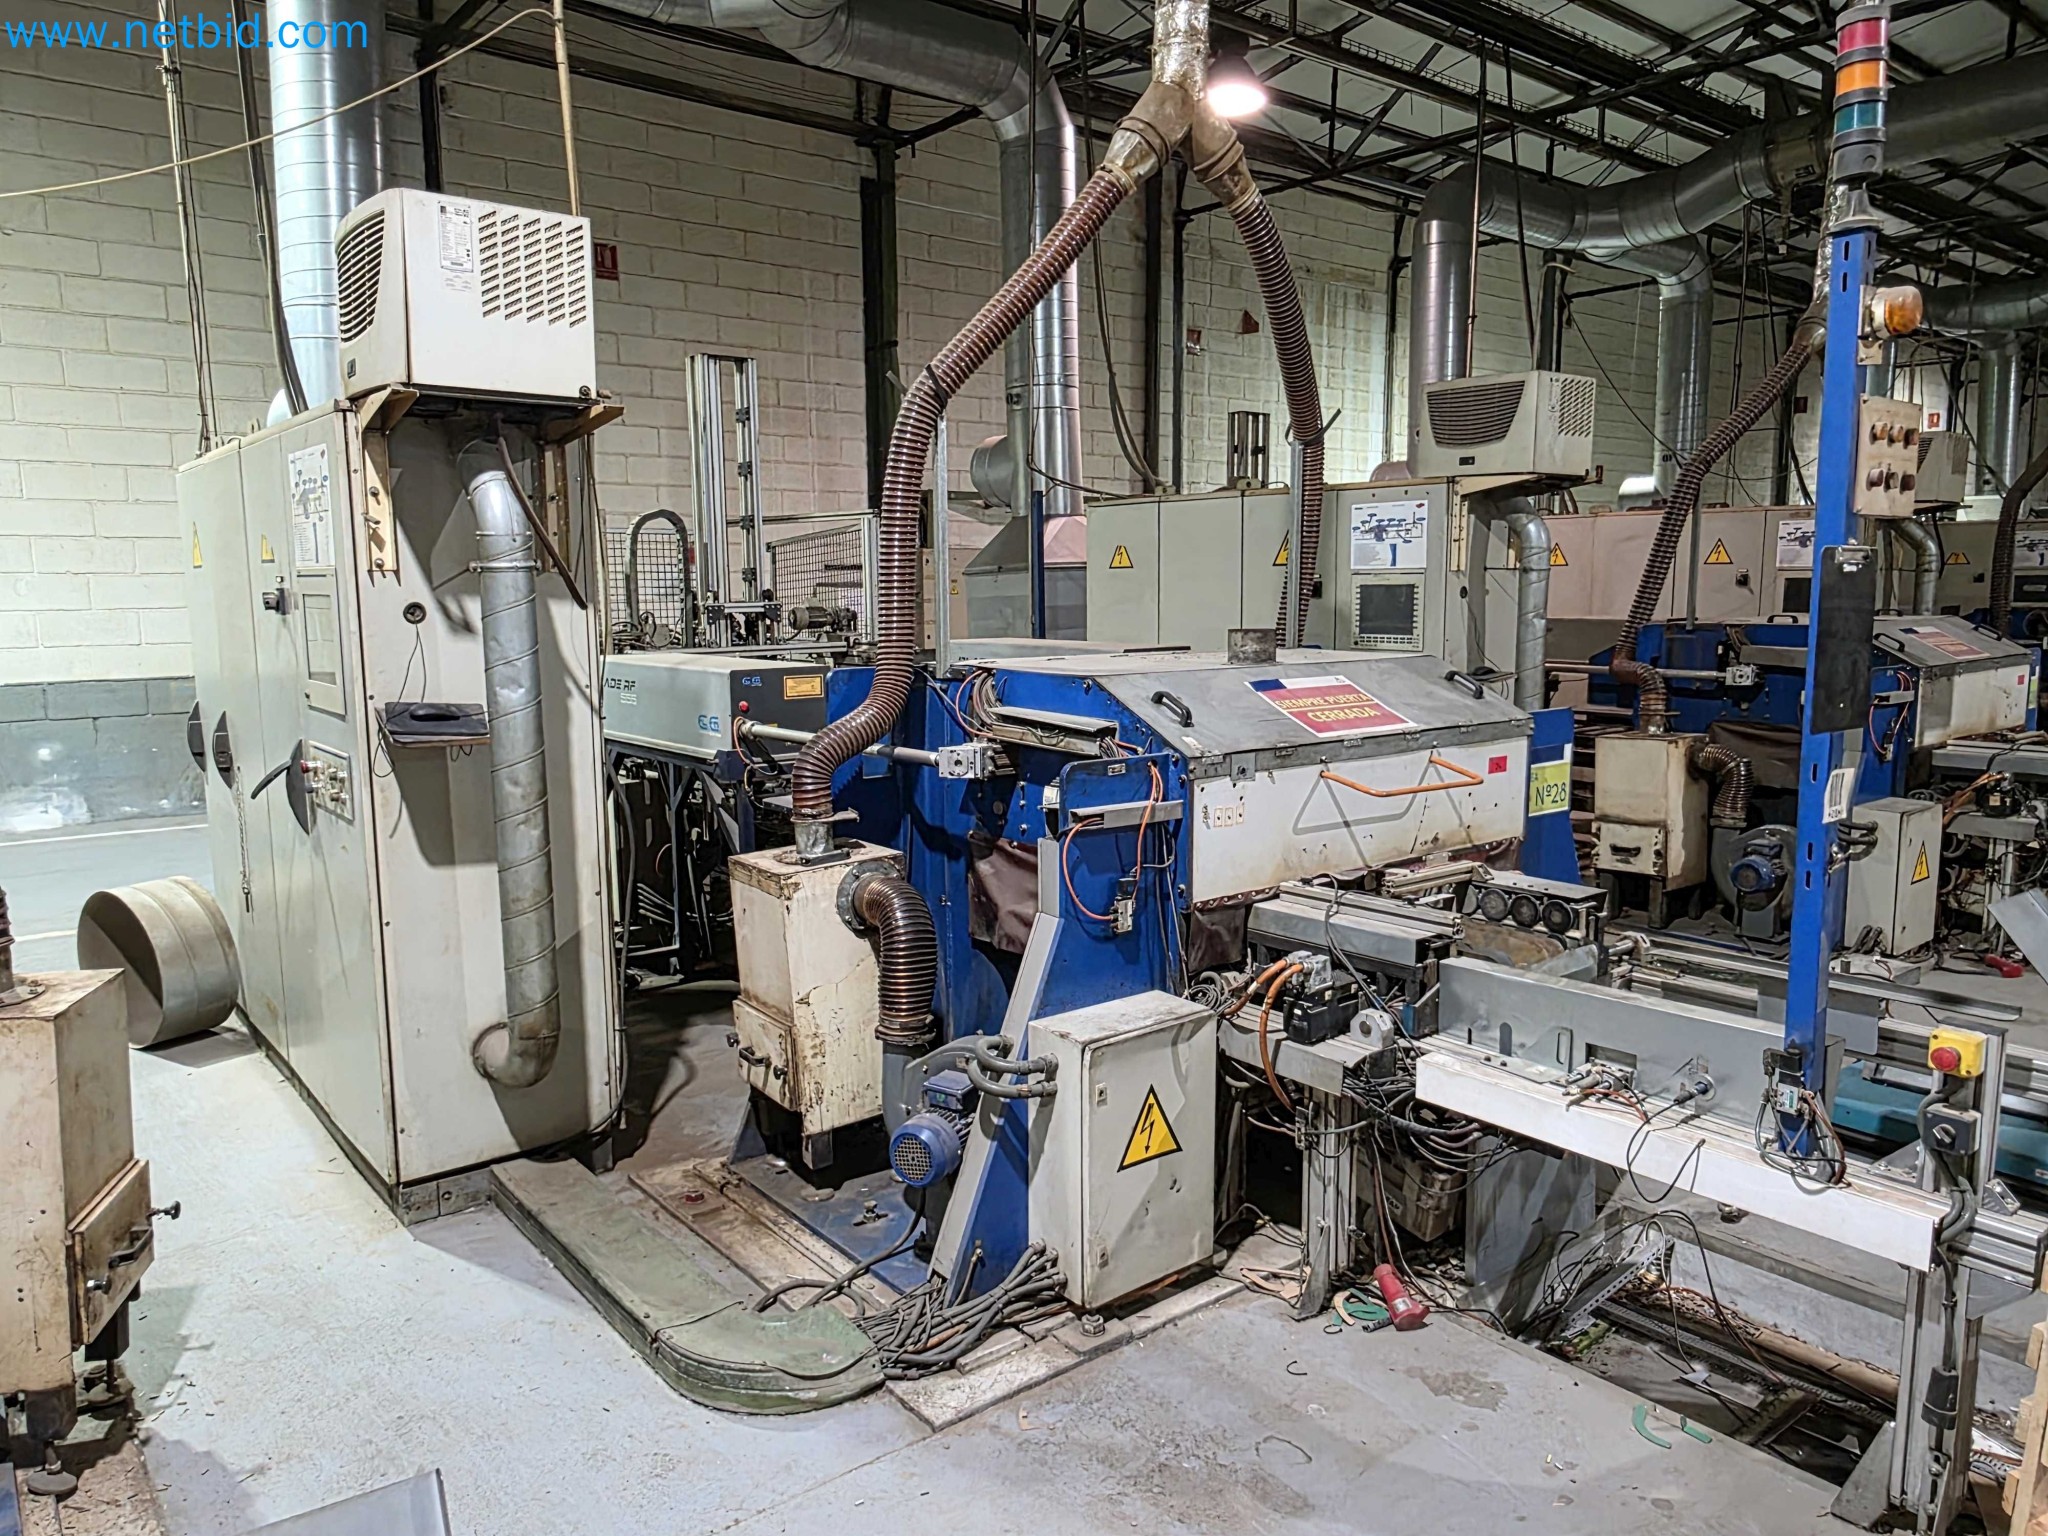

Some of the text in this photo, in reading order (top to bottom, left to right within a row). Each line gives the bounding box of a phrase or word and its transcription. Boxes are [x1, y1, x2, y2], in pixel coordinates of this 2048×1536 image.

[1274, 693, 1371, 710] SIEMPRE PUERTA
[1307, 706, 1380, 722] CERRADA
